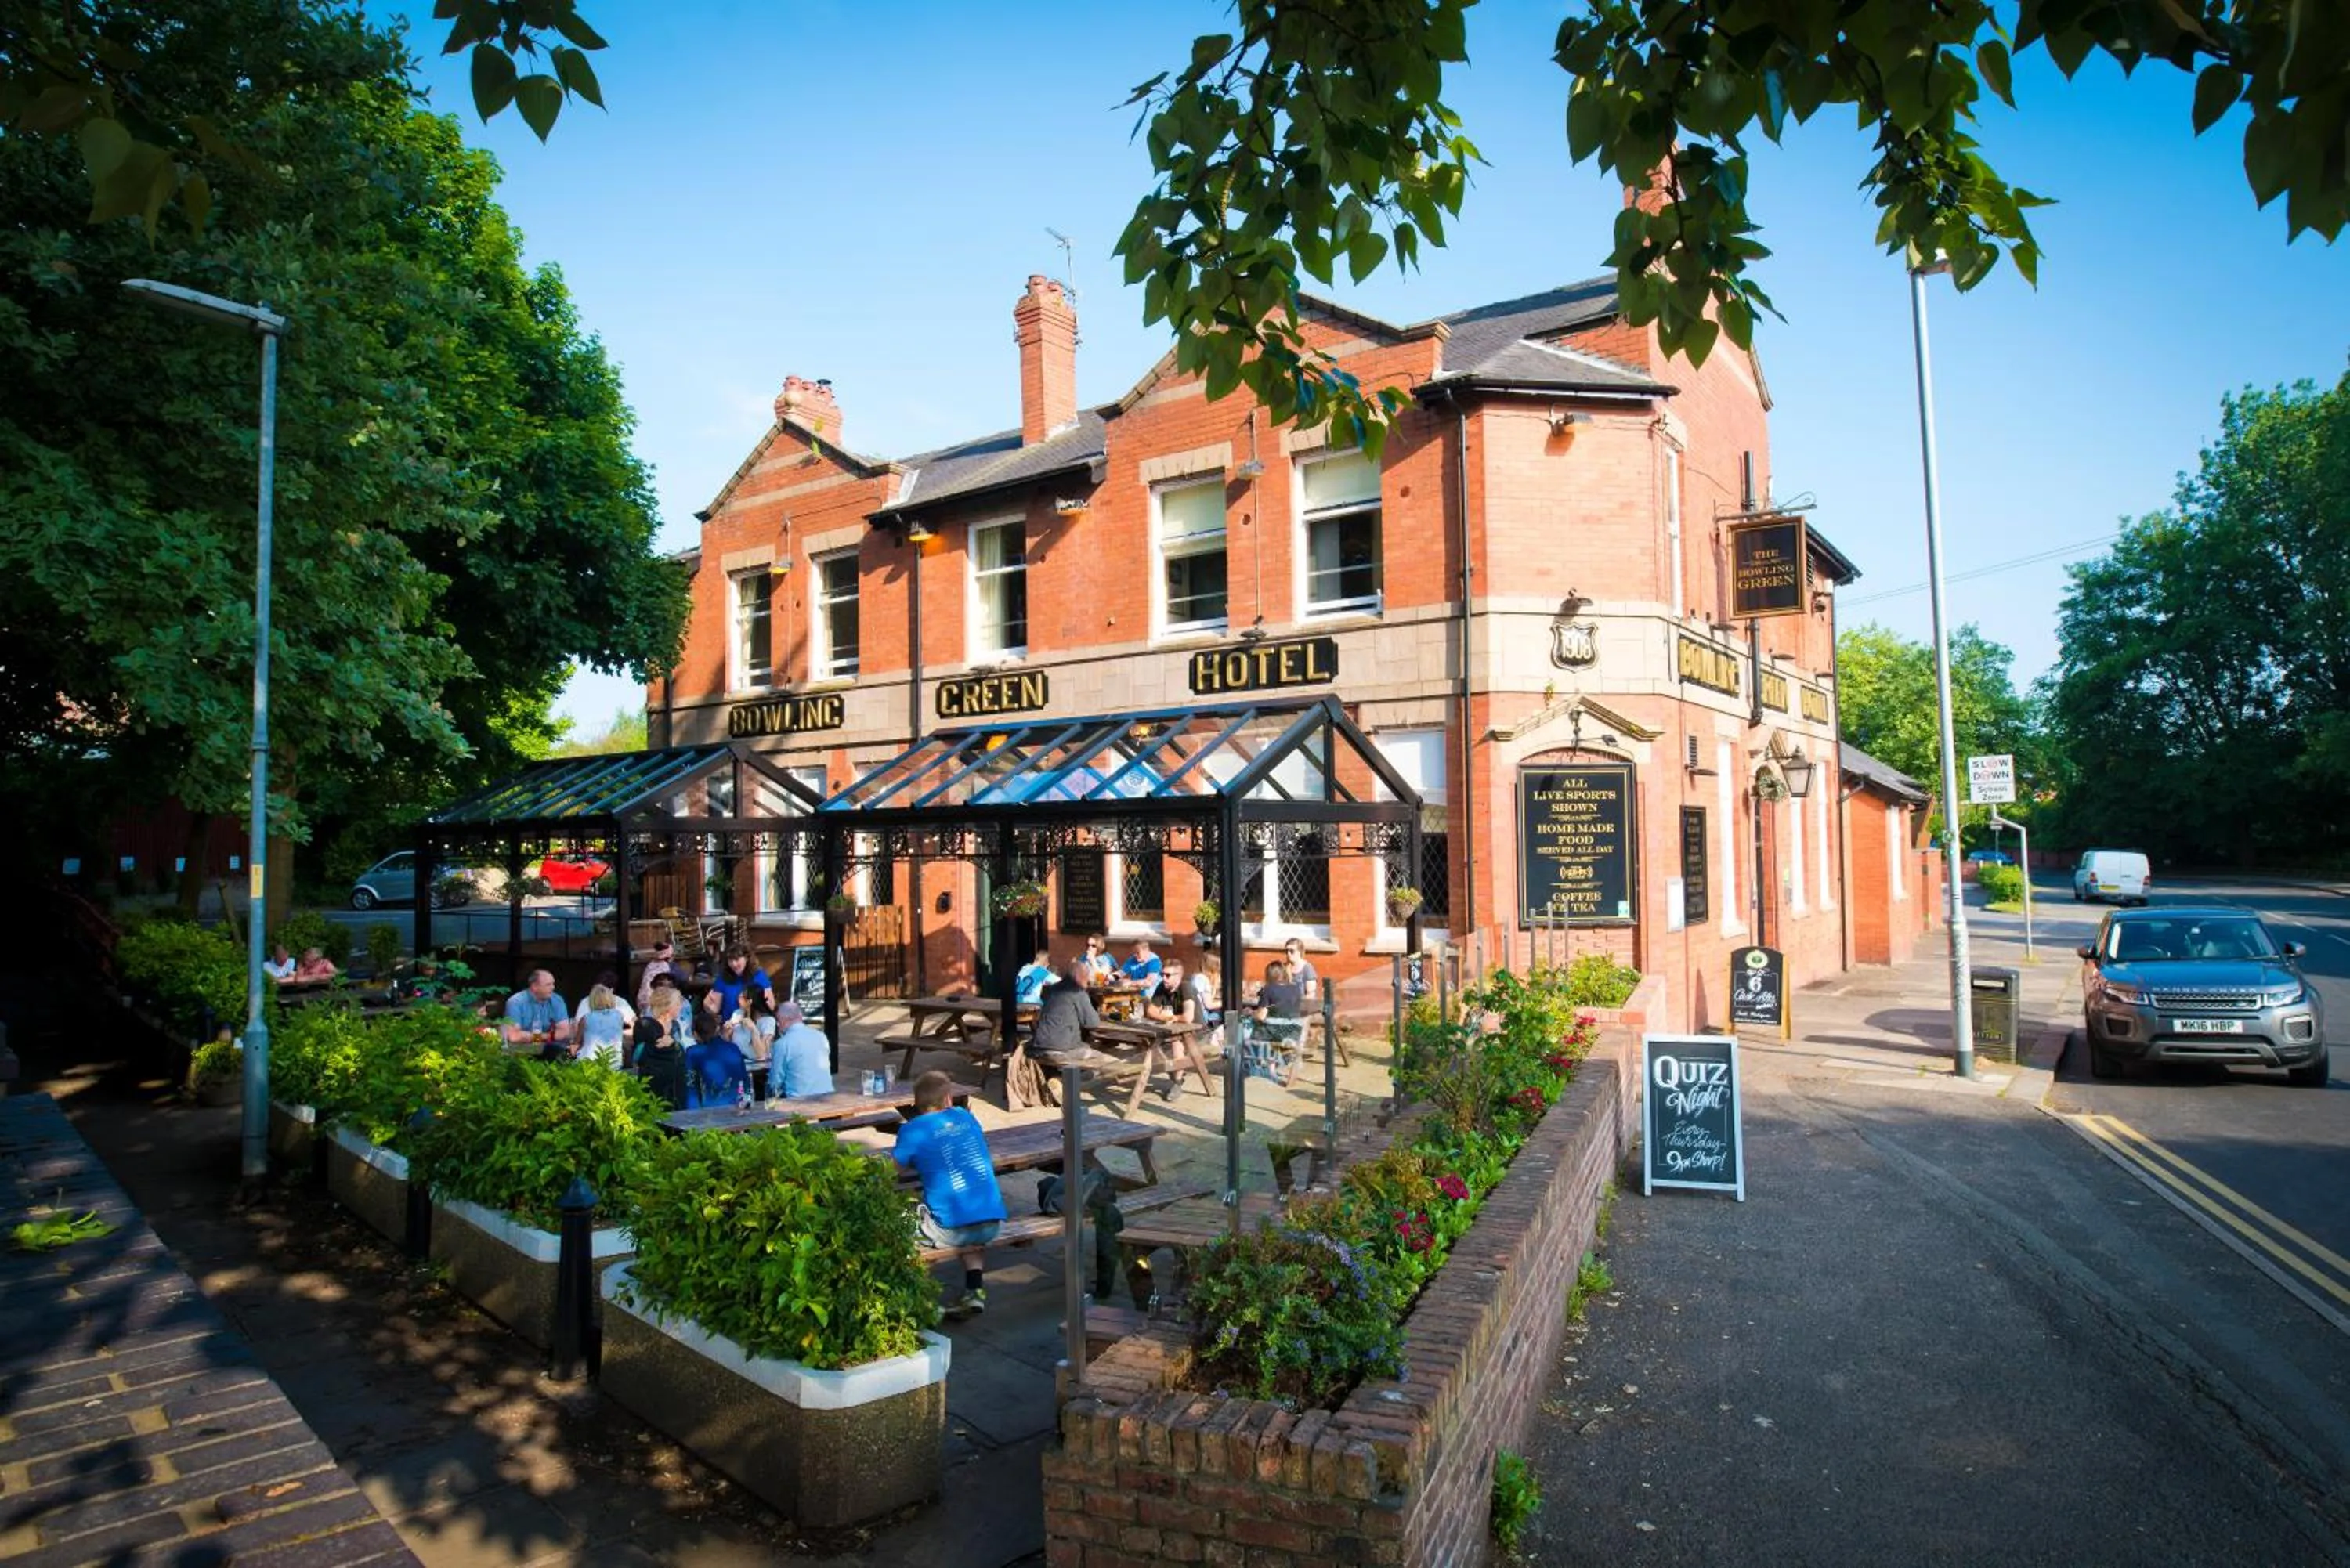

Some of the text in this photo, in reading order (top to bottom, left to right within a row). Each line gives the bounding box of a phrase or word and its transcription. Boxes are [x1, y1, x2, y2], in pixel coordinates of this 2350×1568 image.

[1752, 549, 1779, 559] THE
[1739, 564, 1794, 577] BOWLING
[1737, 574, 1795, 590] GREEN
[1560, 634, 1591, 659] 1908
[732, 642, 1330, 735] BOWLING GREEN HOTEL
[1563, 778, 1588, 788] ALL
[1534, 790, 1616, 800] LIVE SPORTS
[1551, 803, 1598, 812] SHOWN
[1537, 823, 1614, 834] HOME MADE
[1557, 835, 1595, 845] FOOD
[1552, 891, 1603, 901] COFFEE
[1571, 902, 1596, 912] TEA
[1748, 976, 1762, 992] 6
[2180, 1021, 2207, 1030] MK16
[1654, 1055, 1729, 1091] QUIZ
[1666, 1082, 1730, 1118] Night
[1673, 1120, 1710, 1137] Every
[1661, 1133, 1726, 1153] Thursday
